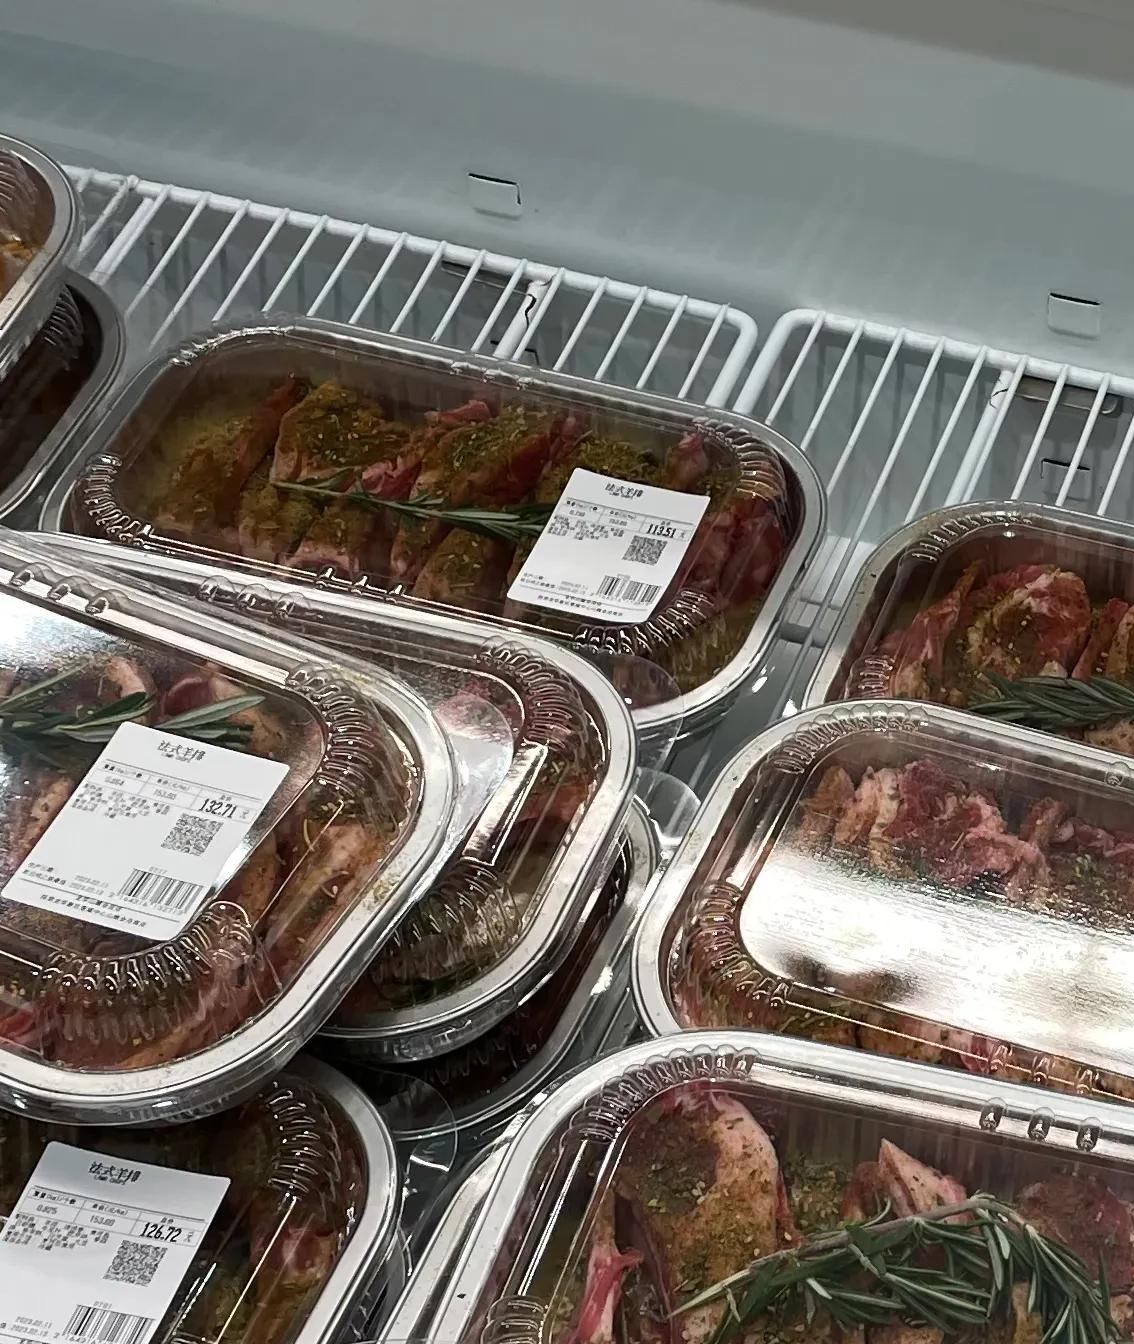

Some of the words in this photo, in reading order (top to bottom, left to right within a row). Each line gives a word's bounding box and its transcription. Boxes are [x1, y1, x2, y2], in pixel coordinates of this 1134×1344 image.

[198, 797, 237, 819] 132.71
[88, 1160, 143, 1183] 法式羊排
[139, 1221, 183, 1244] 126.72
